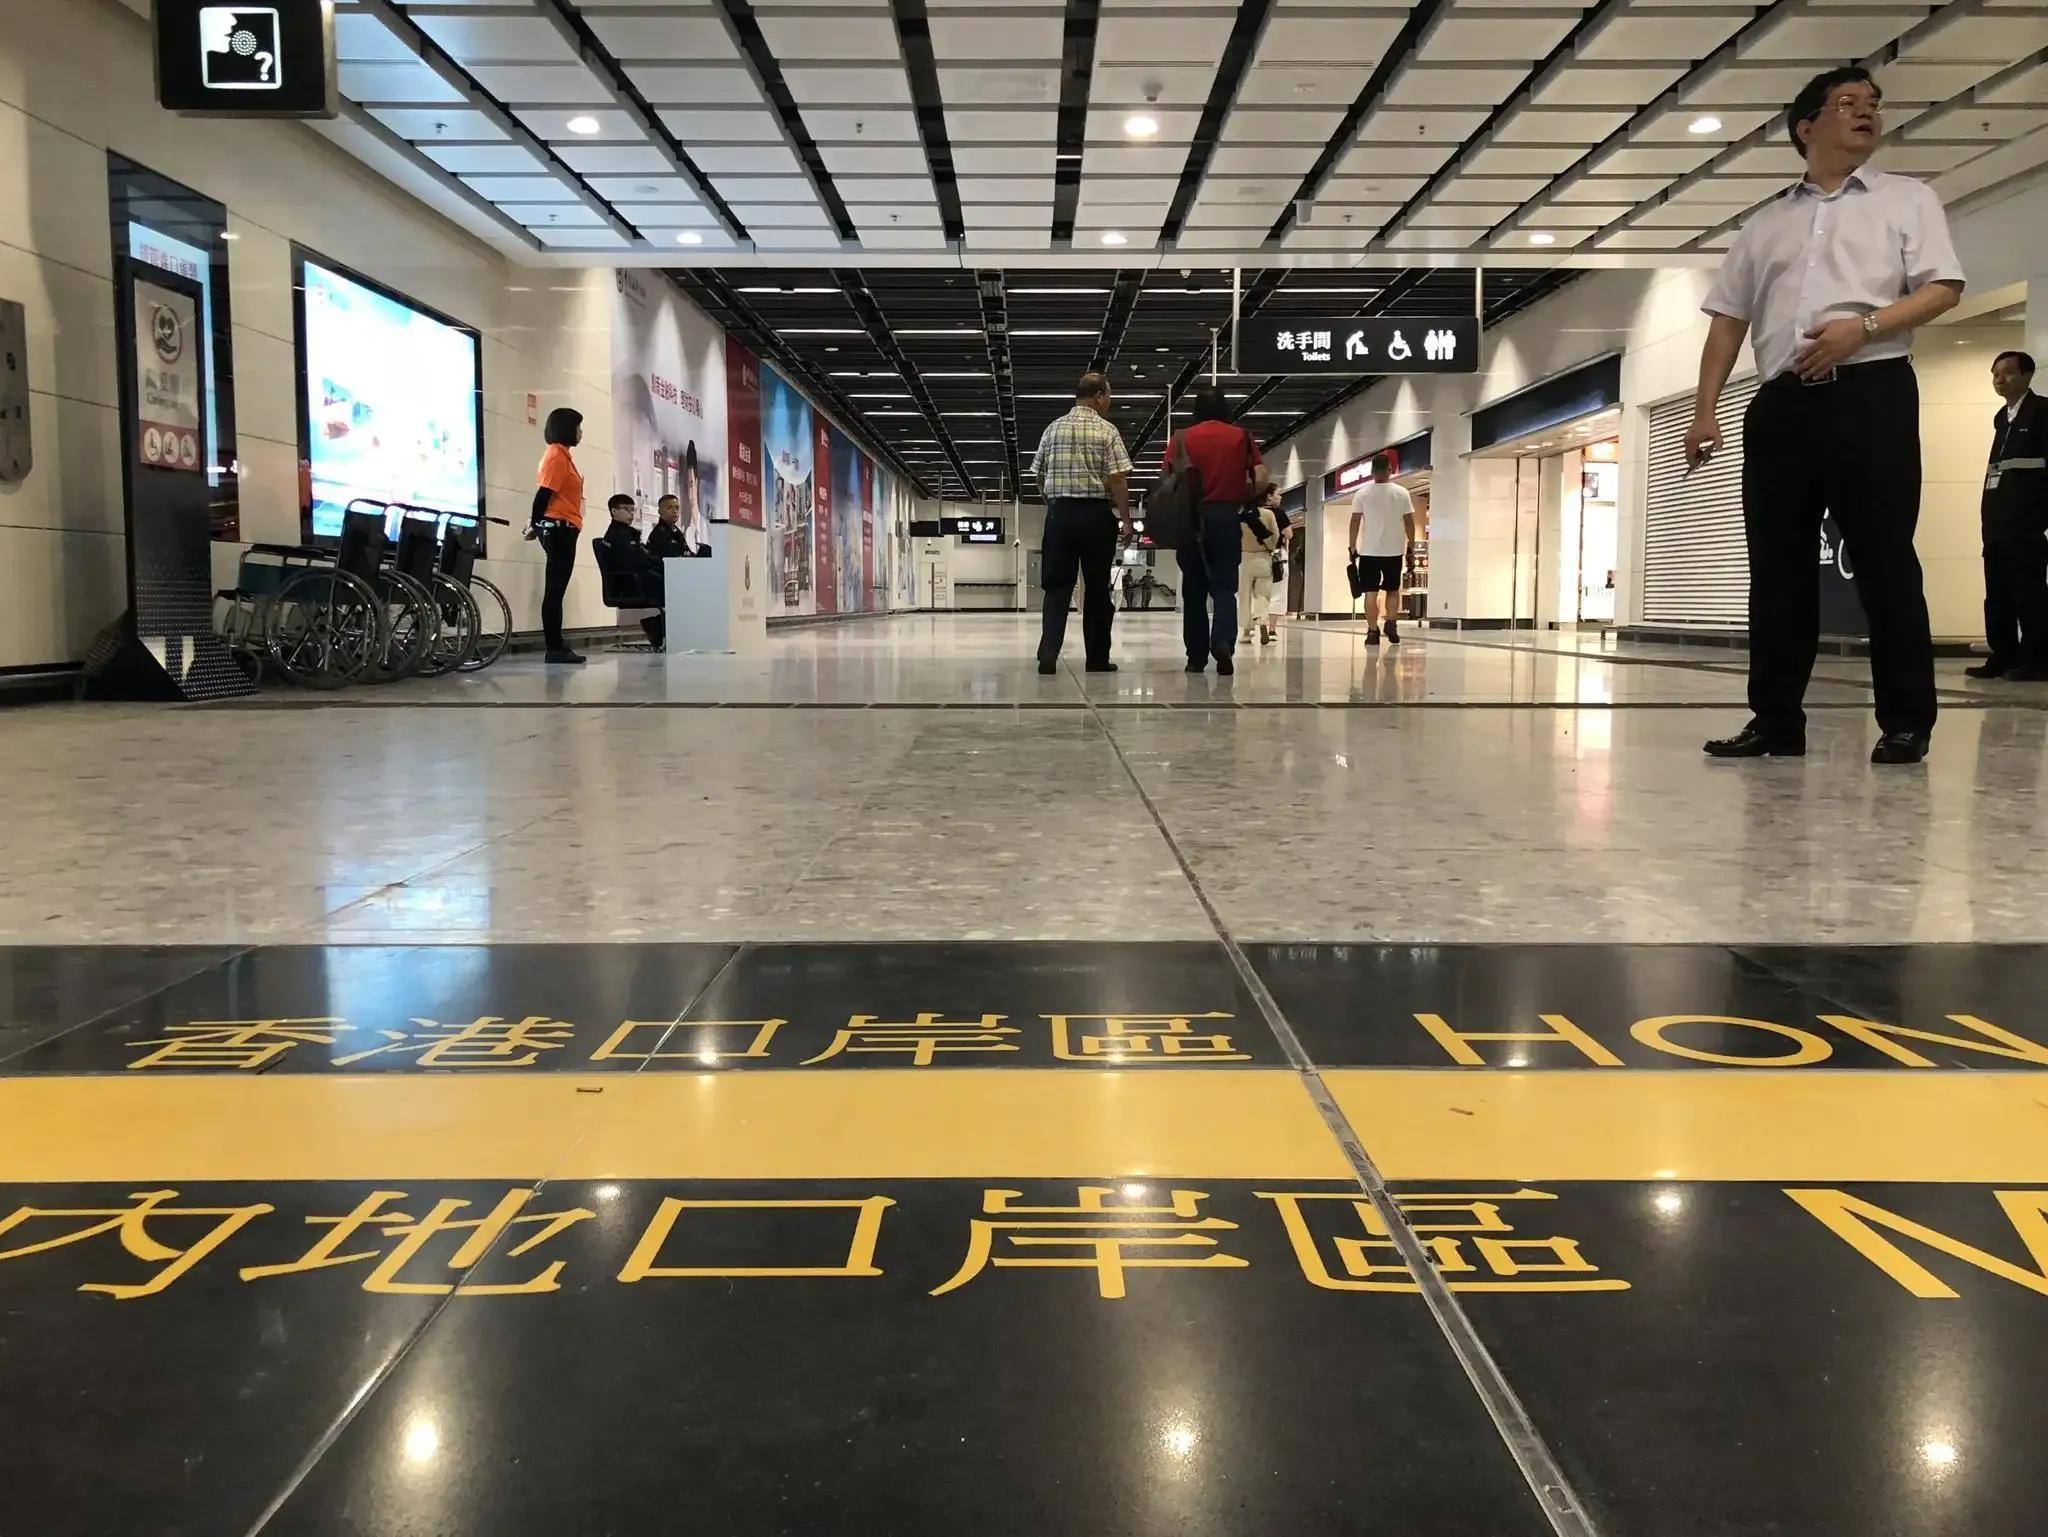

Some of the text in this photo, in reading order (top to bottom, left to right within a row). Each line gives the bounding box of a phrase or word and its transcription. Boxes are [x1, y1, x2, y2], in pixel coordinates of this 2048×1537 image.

[1277, 331, 1331, 350] 洗手間
[1301, 351, 1331, 361] Toilets
[125, 1012, 1252, 1068] 香港口岸區
